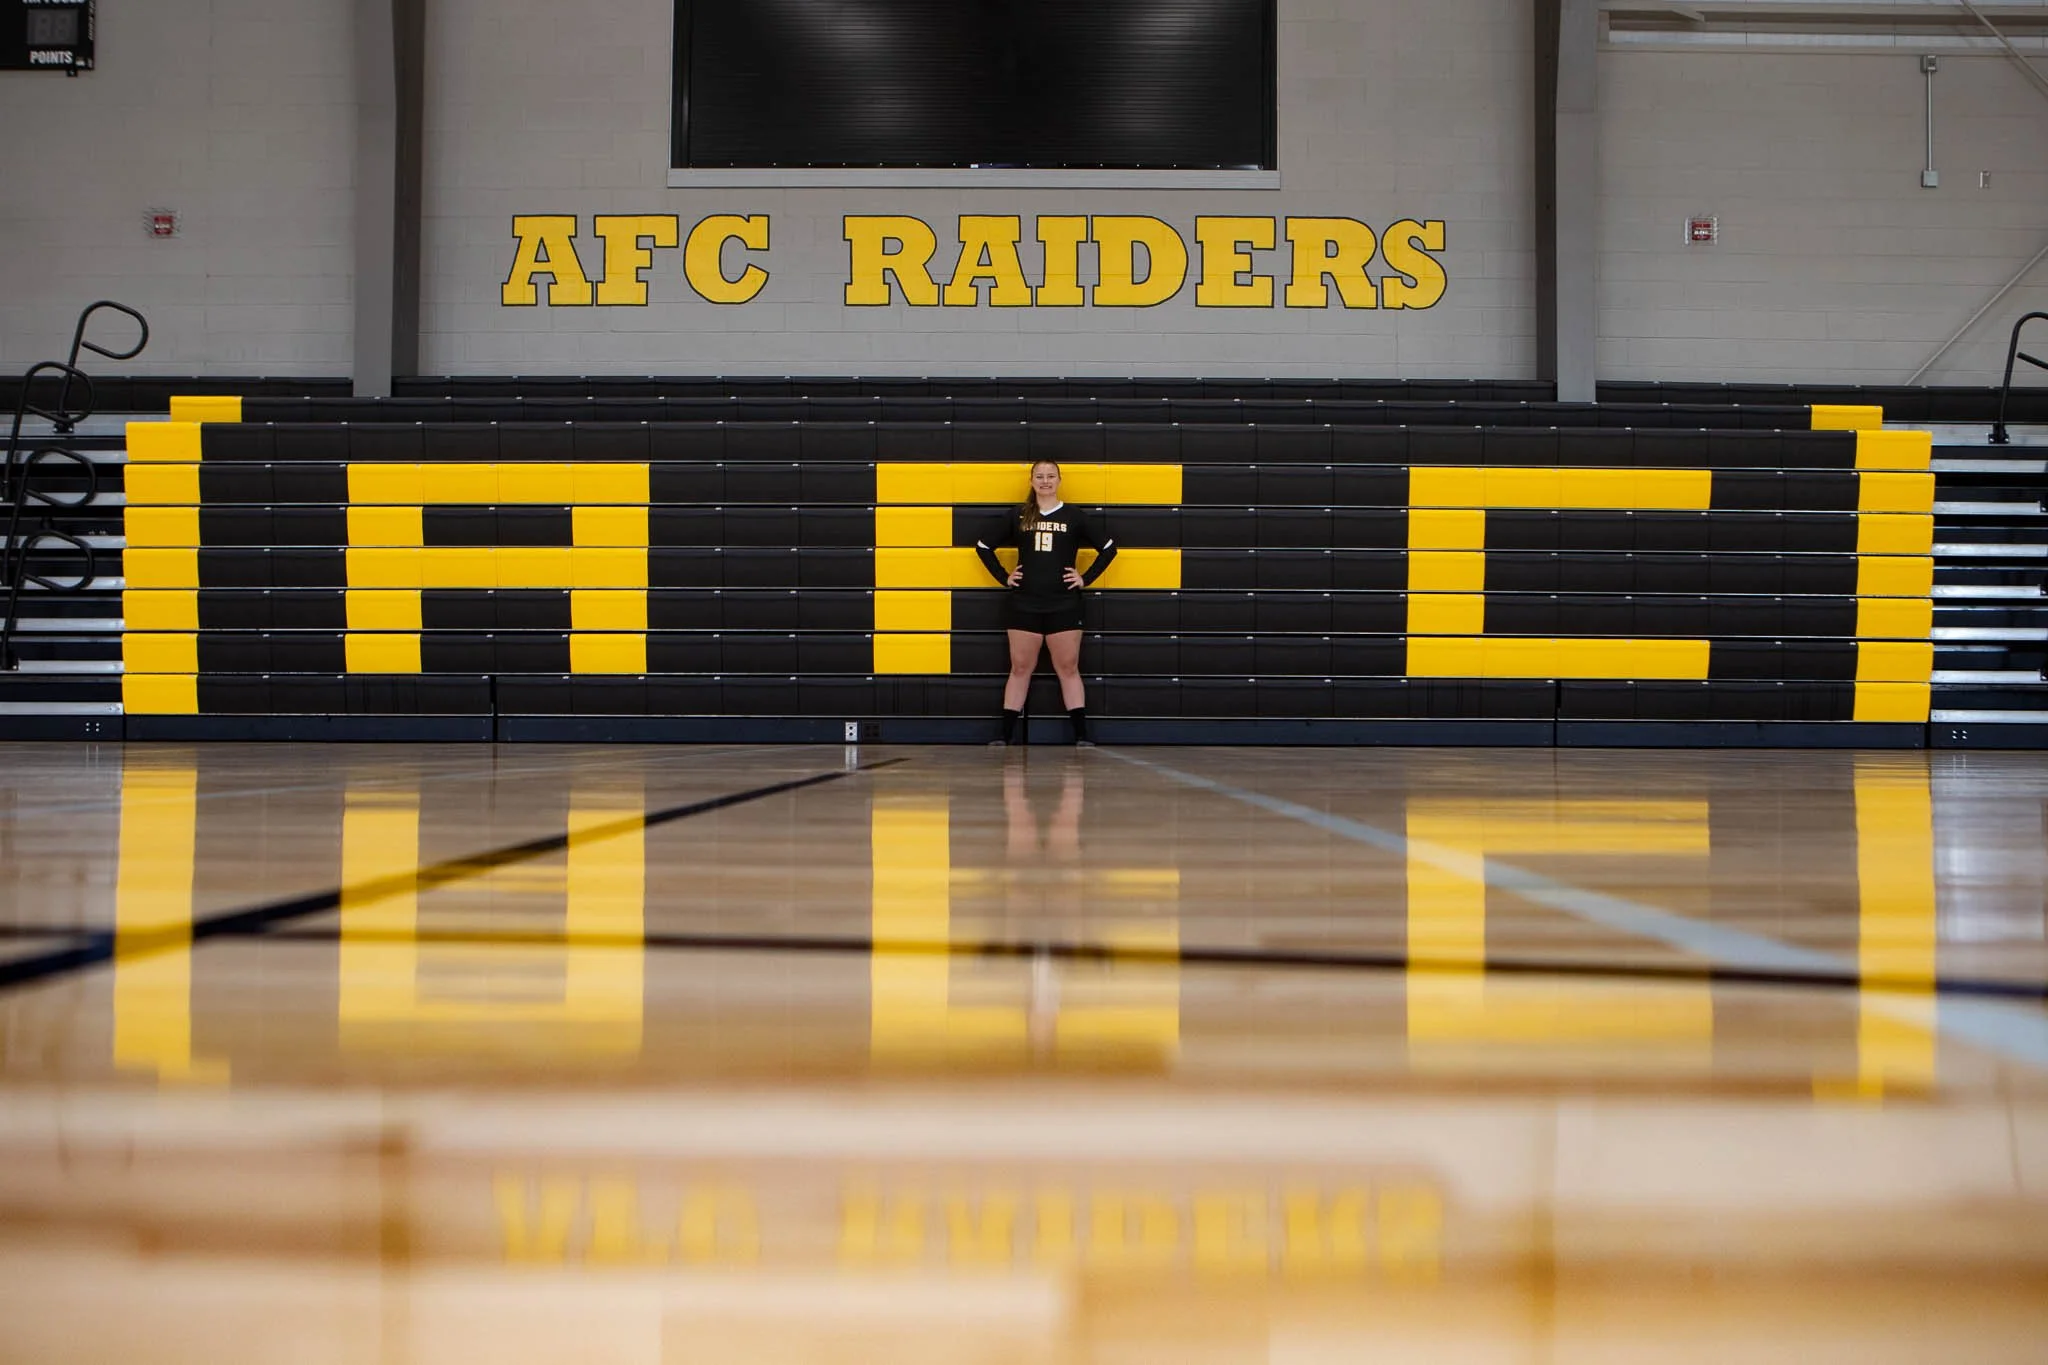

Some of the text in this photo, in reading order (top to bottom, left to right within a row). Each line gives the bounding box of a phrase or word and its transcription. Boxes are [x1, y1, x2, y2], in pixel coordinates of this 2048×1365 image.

[29, 50, 73, 64] POINTS
[502, 213, 1447, 310] AFC RAIDERS
[1024, 521, 1067, 533] IDERS
[1034, 531, 1053, 552] 19
